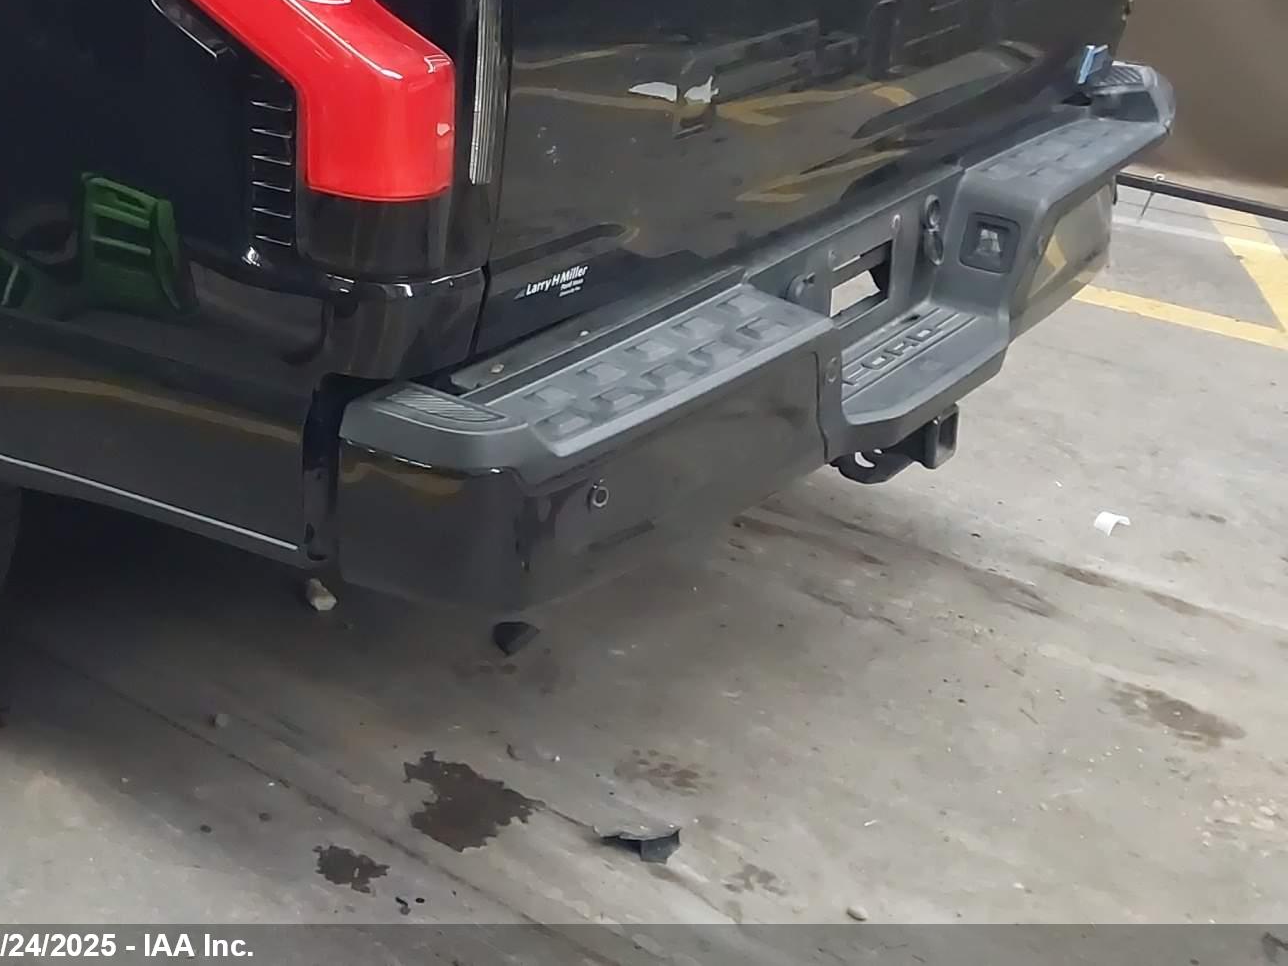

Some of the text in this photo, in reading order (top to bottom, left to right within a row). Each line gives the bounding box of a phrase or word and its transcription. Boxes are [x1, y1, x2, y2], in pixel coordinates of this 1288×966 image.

[526, 279, 552, 296] Larry
[552, 273, 560, 287] H
[560, 265, 588, 283] Miller
